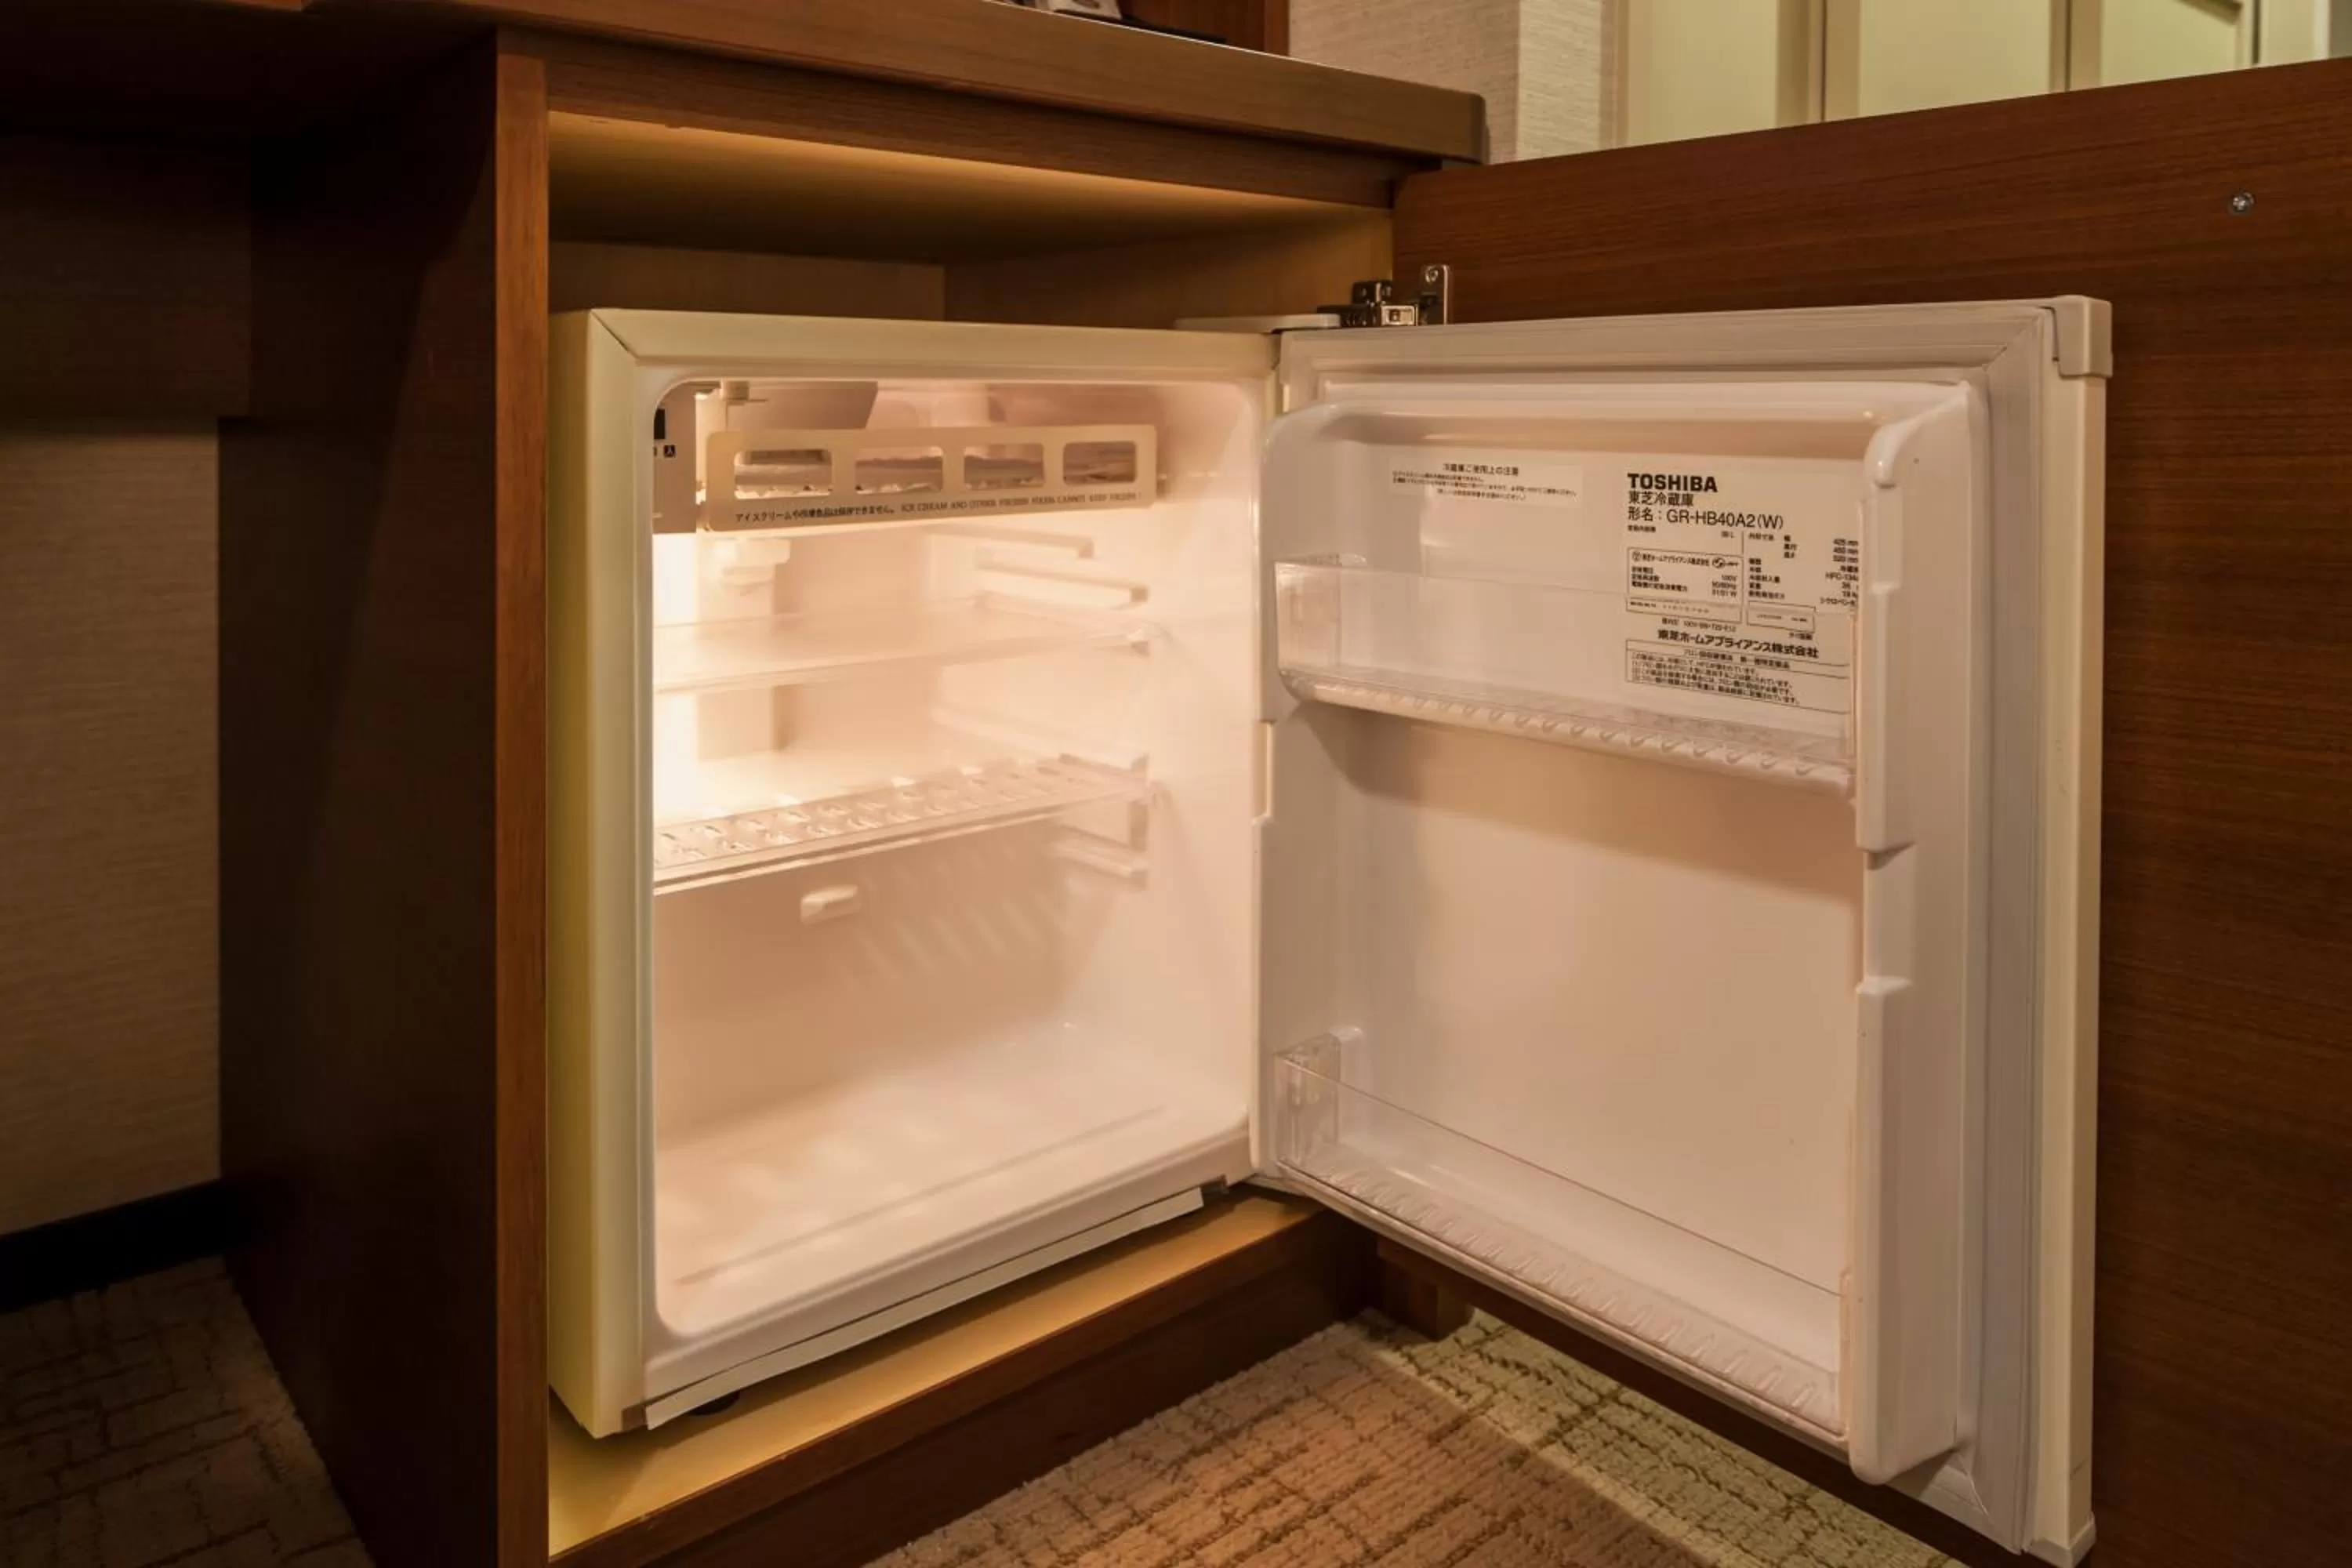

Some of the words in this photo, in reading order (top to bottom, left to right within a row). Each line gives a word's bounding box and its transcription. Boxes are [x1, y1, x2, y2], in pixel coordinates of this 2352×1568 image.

[1628, 473, 1719, 492] TOSHIBA
[1628, 491, 1694, 506] 東芝冷蔵庫
[1657, 629, 1819, 659] 東芝ホームアプライアンス株式会社
